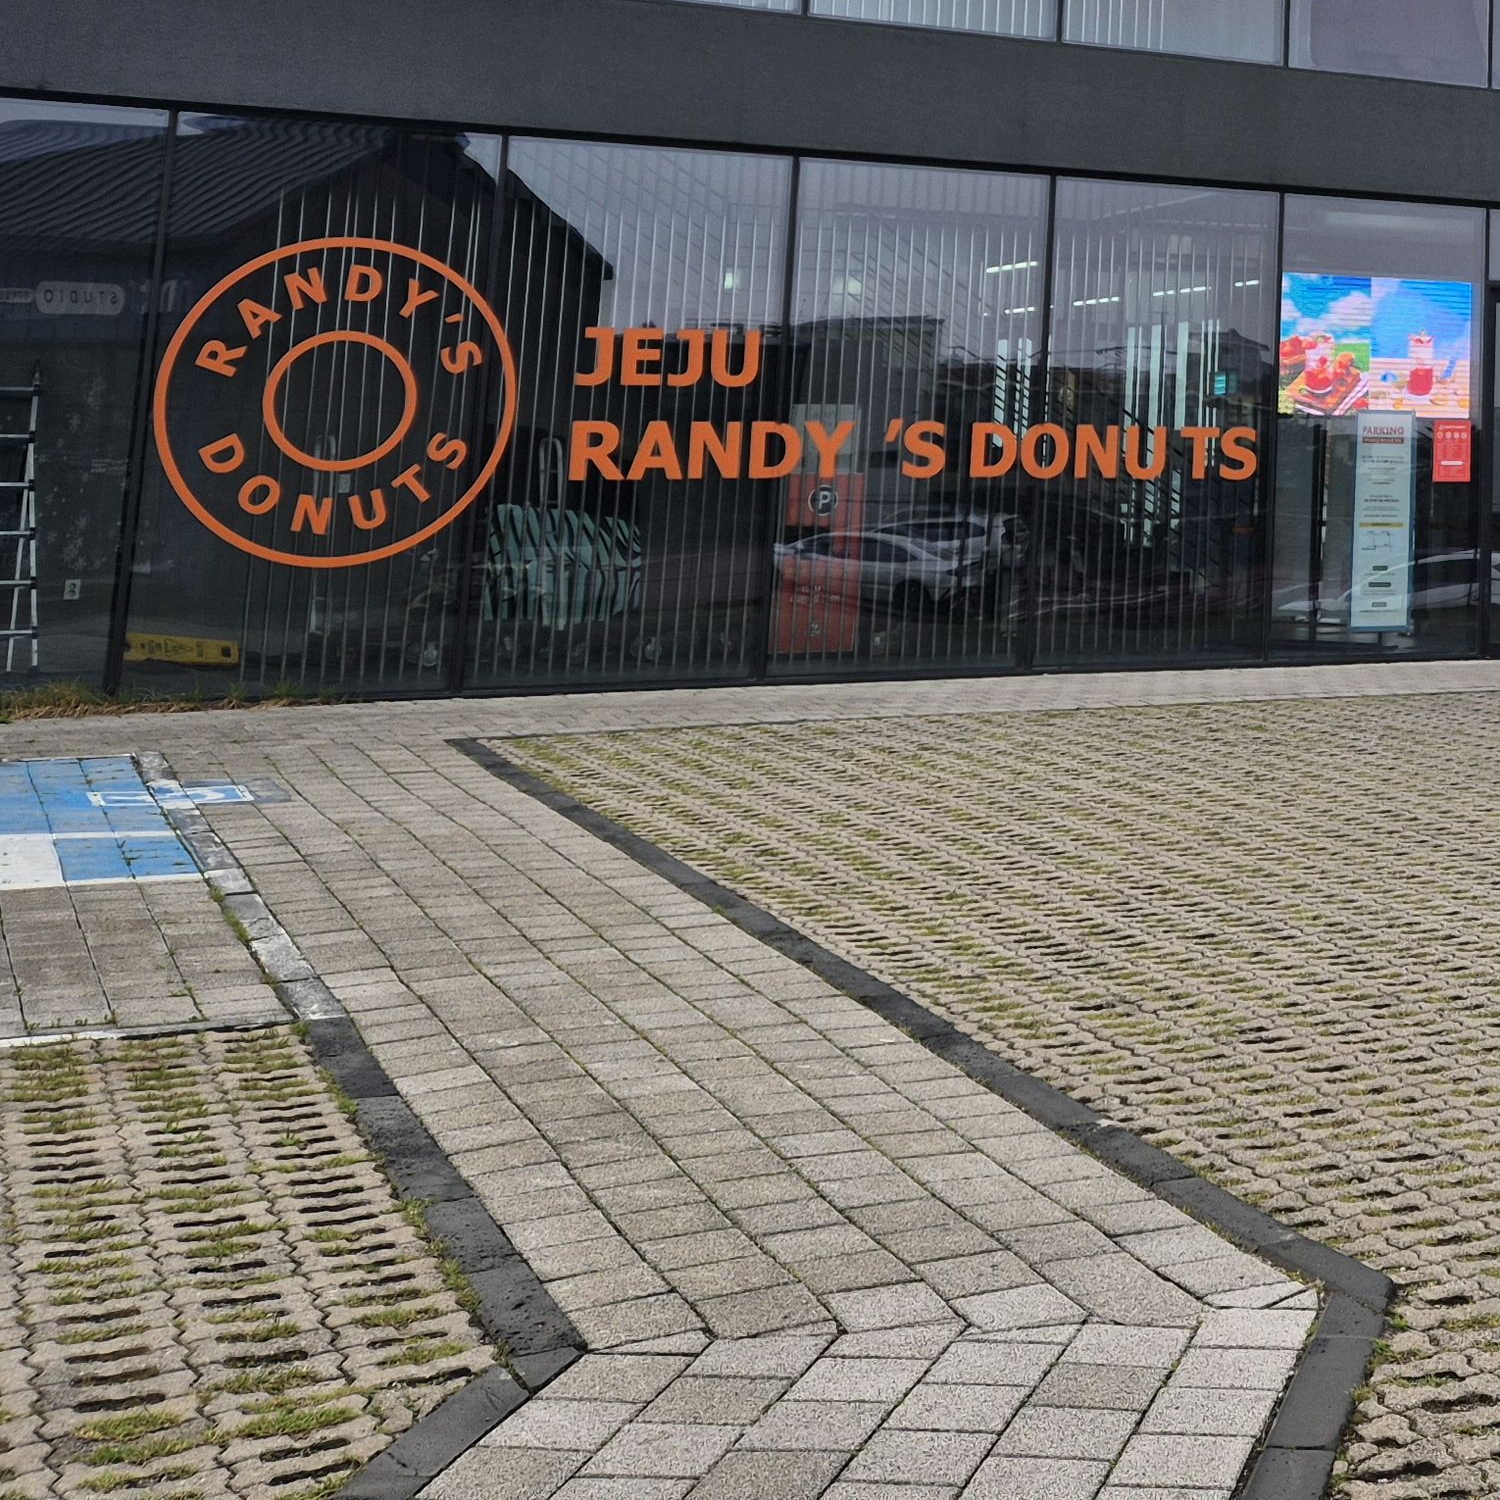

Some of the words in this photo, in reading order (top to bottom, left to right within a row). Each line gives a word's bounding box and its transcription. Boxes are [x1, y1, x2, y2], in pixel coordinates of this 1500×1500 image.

[195, 264, 484, 378] RANDY'S
[574, 327, 762, 388] JEJU
[970, 423, 1259, 480] DONUTS
[1362, 425, 1405, 436] PARKING
[199, 431, 468, 536] DONUTS
